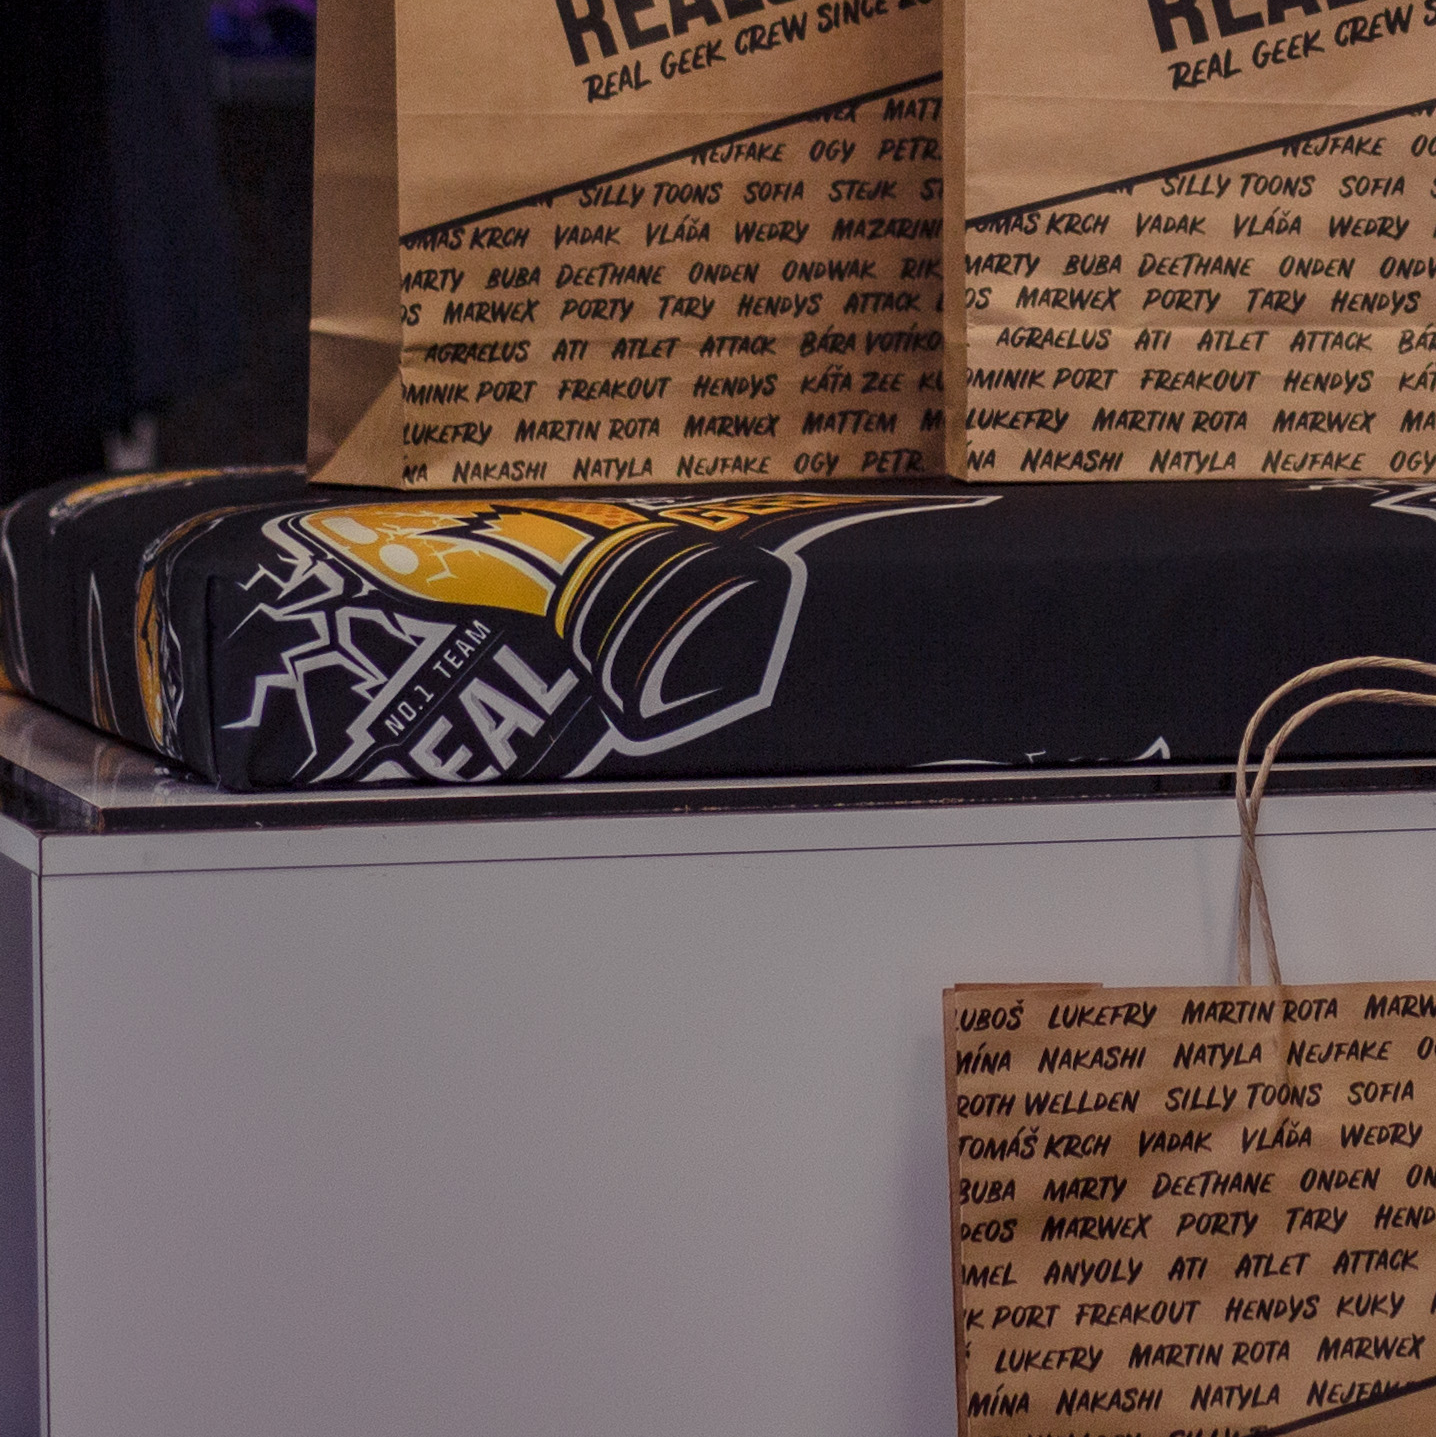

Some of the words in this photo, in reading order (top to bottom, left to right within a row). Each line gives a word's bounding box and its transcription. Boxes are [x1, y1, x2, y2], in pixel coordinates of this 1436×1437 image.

[582, 60, 652, 103] REAL
[660, 39, 726, 80] GEEK
[735, 12, 808, 55] CREW
[1168, 49, 1241, 90] REAL
[1252, 30, 1325, 69] GEEK
[1334, 4, 1415, 46] CREW
[653, 182, 723, 207] TOONS
[744, 180, 804, 204] SOFIA
[828, 179, 897, 202] STEJK
[1241, 173, 1315, 197] TOONS
[1339, 175, 1405, 198] SOFIA
[1045, 213, 1109, 235] KRCH
[1136, 213, 1205, 237] VADAK
[1329, 216, 1409, 240] WEDRY
[485, 266, 541, 289] BUBA
[556, 262, 665, 289] DEETHANE
[688, 261, 760, 284] ONDEN
[782, 259, 876, 282] ONDWAK
[1063, 254, 1121, 276] BUBA
[1138, 253, 1251, 278] DEETHANE
[1279, 256, 1355, 279] ONDEN
[424, 341, 531, 365] AGRAELUS
[552, 338, 589, 361] ATI
[611, 337, 680, 360] ATLET
[699, 335, 776, 357] ATTACK
[799, 324, 856, 358] BÁRA
[996, 326, 1111, 350] AGRAELUS
[1135, 329, 1171, 350] ATI
[1197, 329, 1269, 351] ATLET
[1290, 330, 1371, 352] ATTACK
[1053, 368, 1118, 390] PORT
[1140, 369, 1260, 392] FREAKOUT
[1283, 370, 1374, 394] HENDYS
[515, 419, 601, 442] MARTIN
[608, 417, 659, 440] ROTA
[684, 413, 780, 438] MARWEX
[802, 409, 897, 434] MATTEM
[384, 685, 434, 736] NO.1
[433, 619, 491, 678] TEAM
[359, 644, 579, 782] EAL
[1048, 1001, 1157, 1029] LUKEFRY
[1182, 1000, 1275, 1024] MARTIN
[1283, 998, 1337, 1023] ROTA
[1038, 1046, 1146, 1074] NAKASHI
[1173, 1042, 1261, 1070] NATYLA
[1286, 1040, 1391, 1067] NEJFAKE
[1025, 1090, 1140, 1116] WELLDEN
[1165, 1085, 1237, 1112] SILLY
[1247, 1078, 1322, 1109] TOONS
[1348, 1080, 1413, 1105] SOFIA
[1043, 1175, 1127, 1203] MARTY
[1152, 1170, 1275, 1199] DEETHANE
[1300, 1168, 1380, 1192] ONDEN
[1044, 1257, 1143, 1286] ANYOLY
[1168, 1256, 1208, 1281] ATI
[1235, 1253, 1310, 1278] ATLET
[1333, 1249, 1418, 1275] ATTACK
